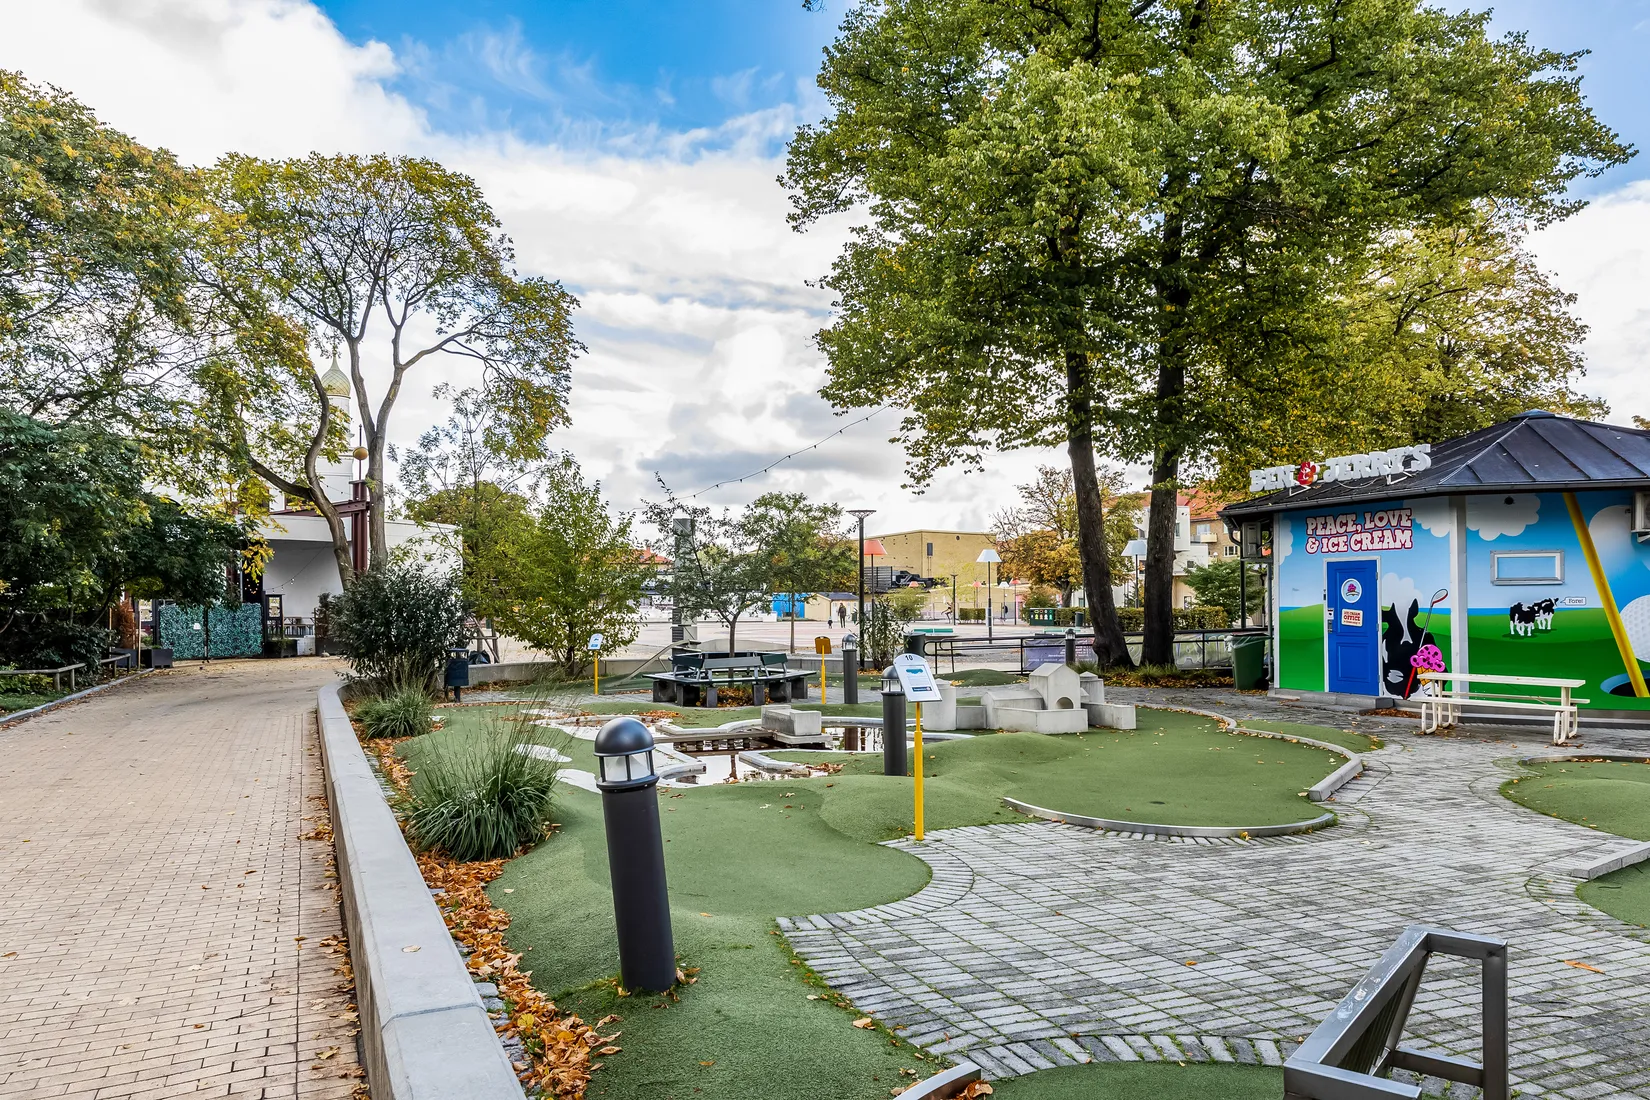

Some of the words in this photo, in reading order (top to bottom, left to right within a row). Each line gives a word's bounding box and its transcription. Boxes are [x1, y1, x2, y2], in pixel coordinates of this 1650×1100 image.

[1250, 465, 1297, 492] BEN
[1298, 461, 1318, 485] &
[1323, 444, 1431, 482] JERRY'S
[1306, 512, 1362, 536] PEACE,
[1364, 508, 1412, 530] LOVE
[1306, 537, 1320, 554] &
[1321, 535, 1348, 553] ICE
[1350, 529, 1413, 551] CREAM
